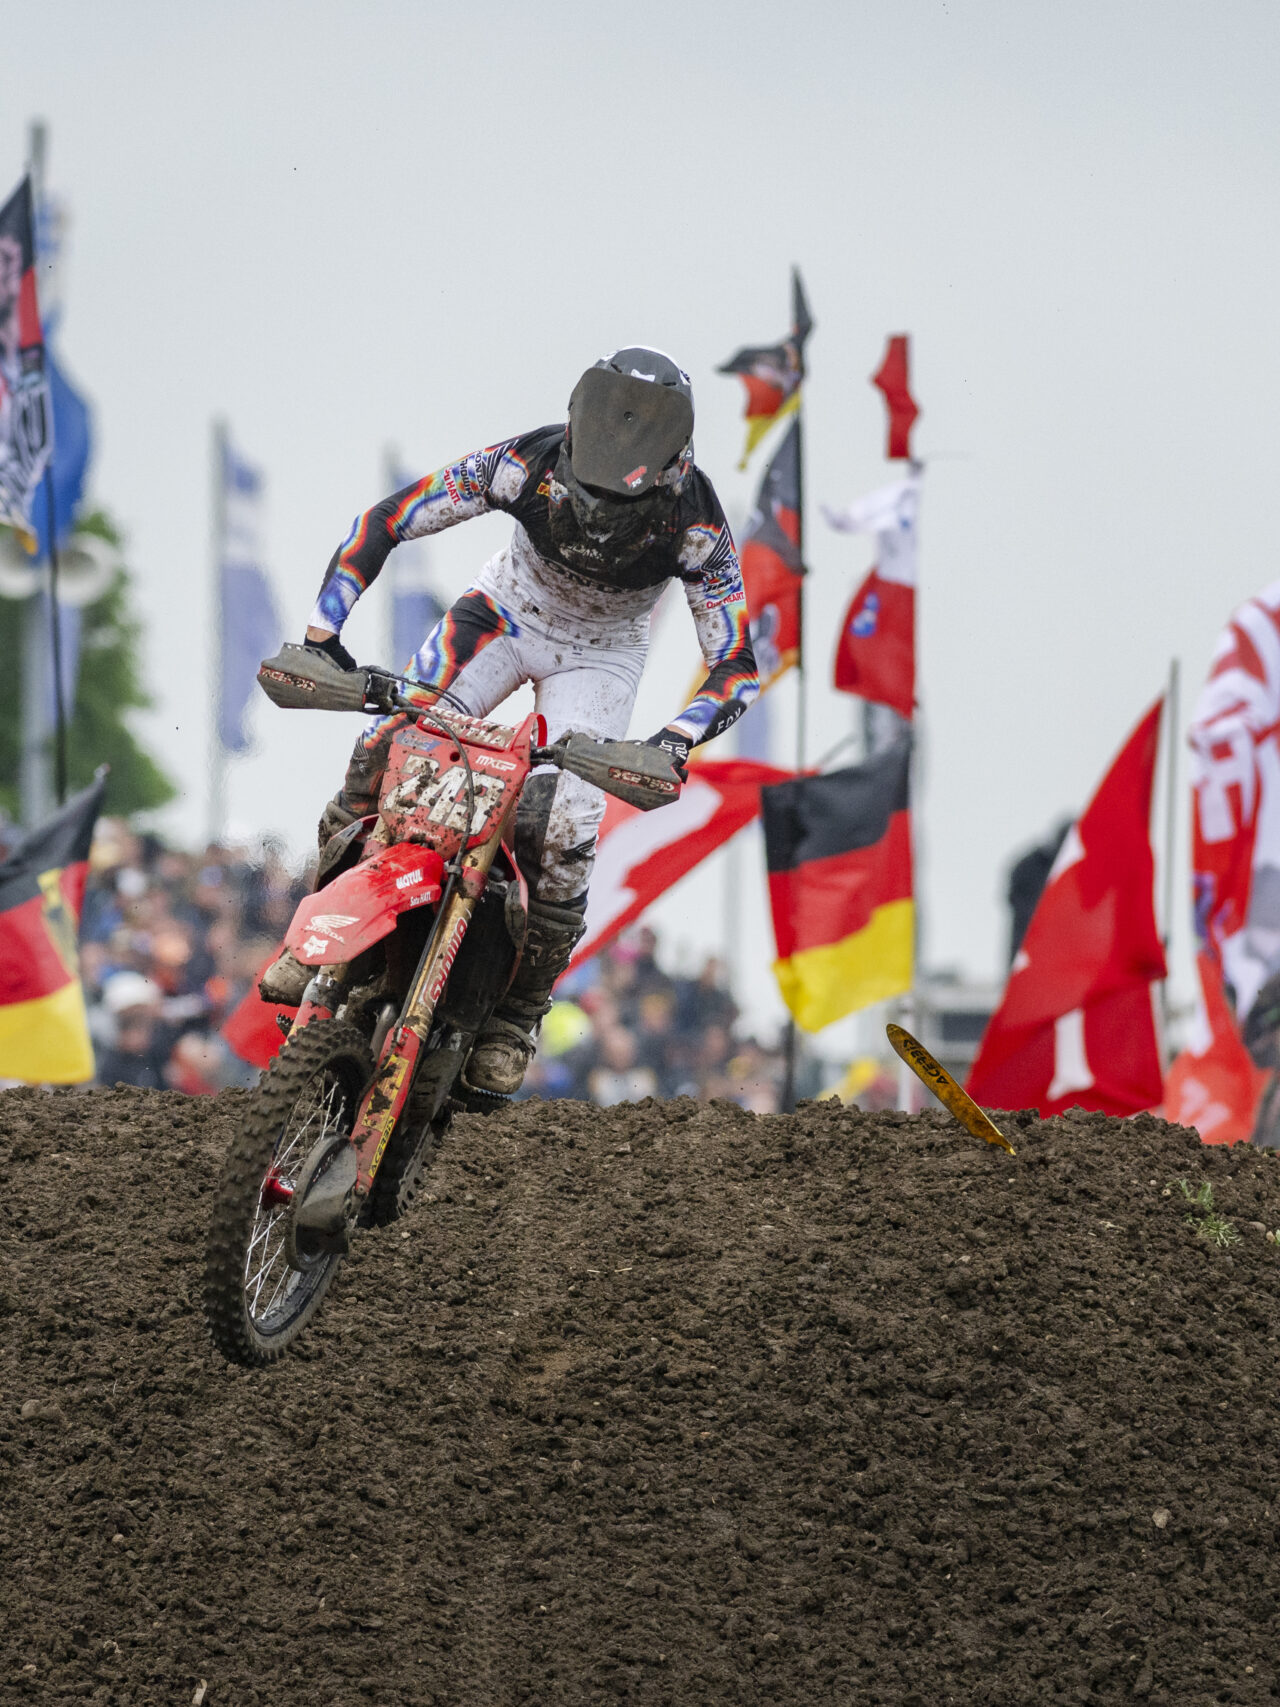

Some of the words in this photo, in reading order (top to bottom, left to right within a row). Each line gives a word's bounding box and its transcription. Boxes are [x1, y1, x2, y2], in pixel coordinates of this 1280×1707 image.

[383, 754, 507, 836] 243
[396, 869, 423, 890] MOTUL
[305, 924, 345, 945] HONDA
